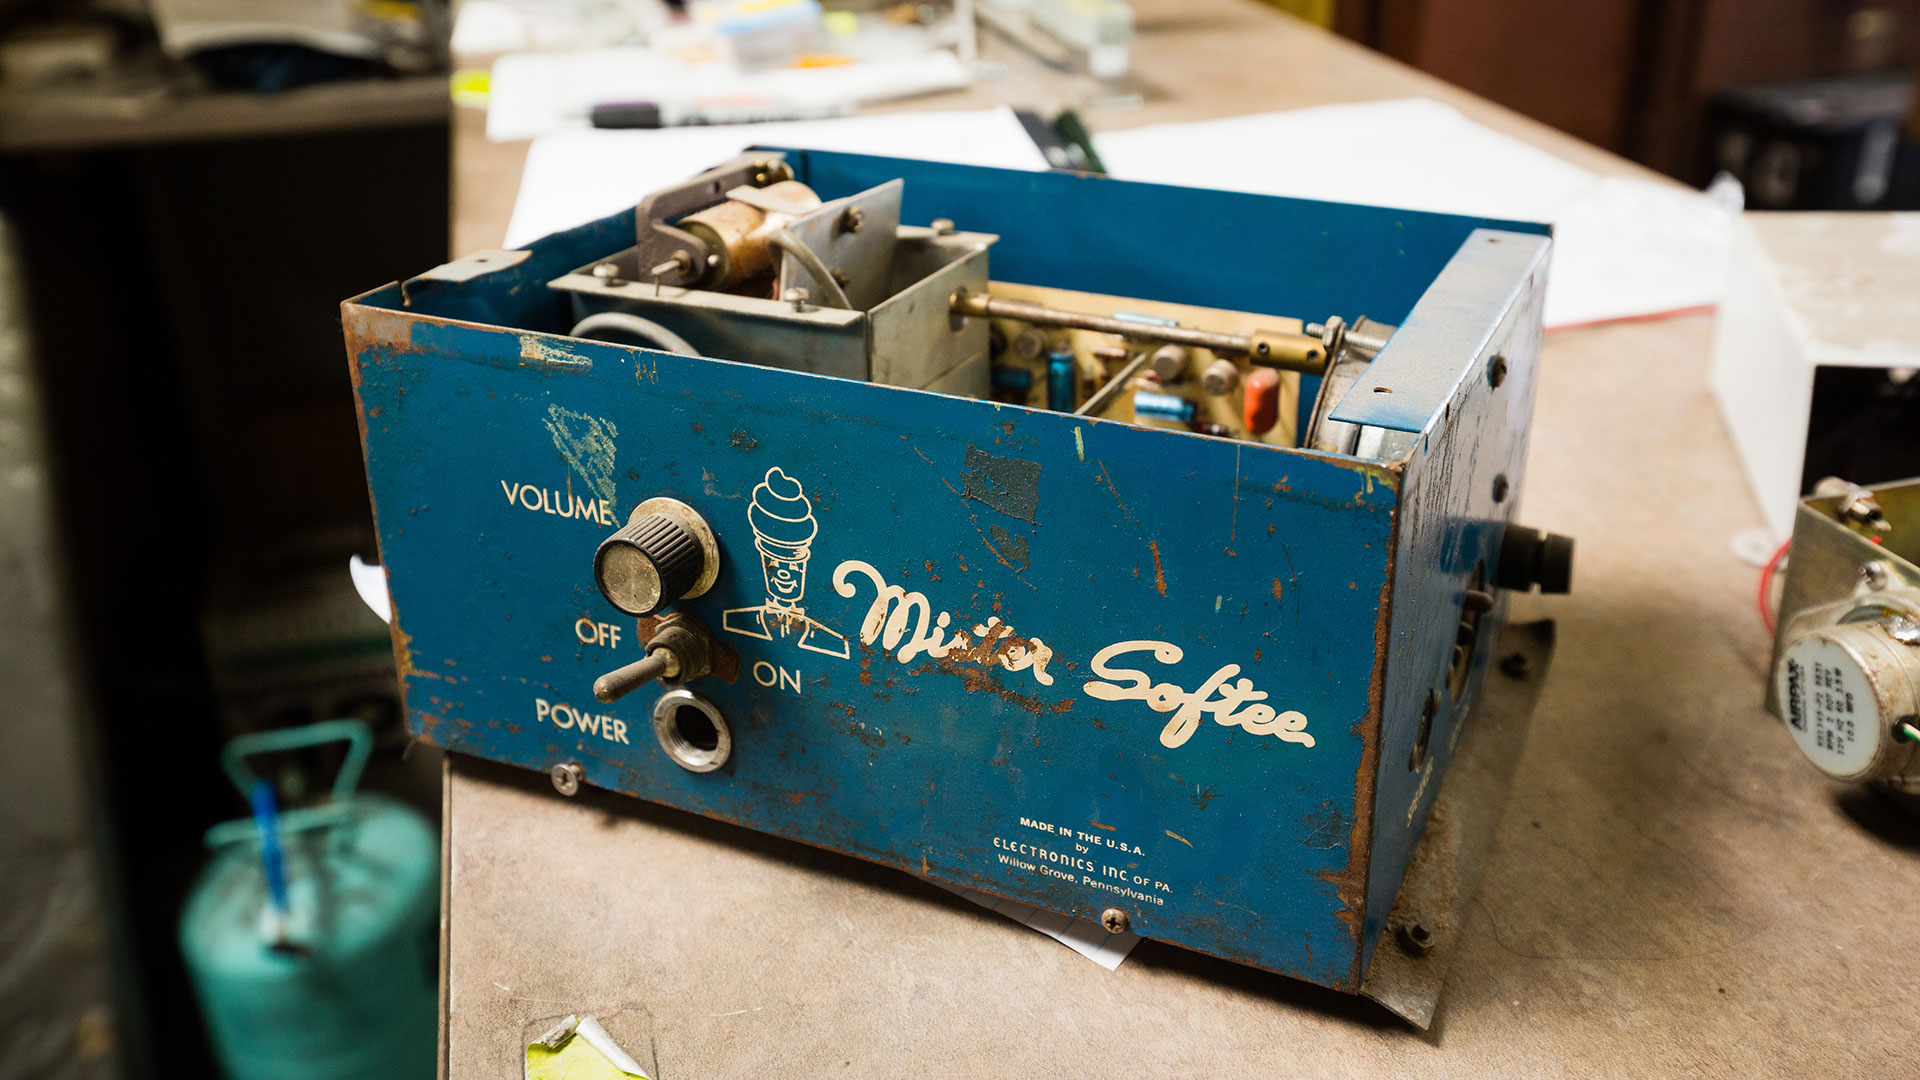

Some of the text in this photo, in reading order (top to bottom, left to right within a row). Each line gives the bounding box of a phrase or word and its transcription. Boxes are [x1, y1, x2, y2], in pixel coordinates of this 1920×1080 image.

[501, 480, 613, 526] VOLUME
[575, 618, 621, 649] OFF
[753, 661, 801, 694] ON
[1083, 640, 1316, 749] Softee
[1788, 658, 1802, 731] AIRPAX
[535, 698, 630, 745] POWER
[1020, 817, 1146, 857] MADE IN THE U.S.A.
[1075, 843, 1089, 854] by
[998, 853, 1036, 871] Willow
[1082, 876, 1164, 906] Pennsylvania
[1133, 875, 1150, 887] OF
[1154, 881, 1173, 894] PA.
